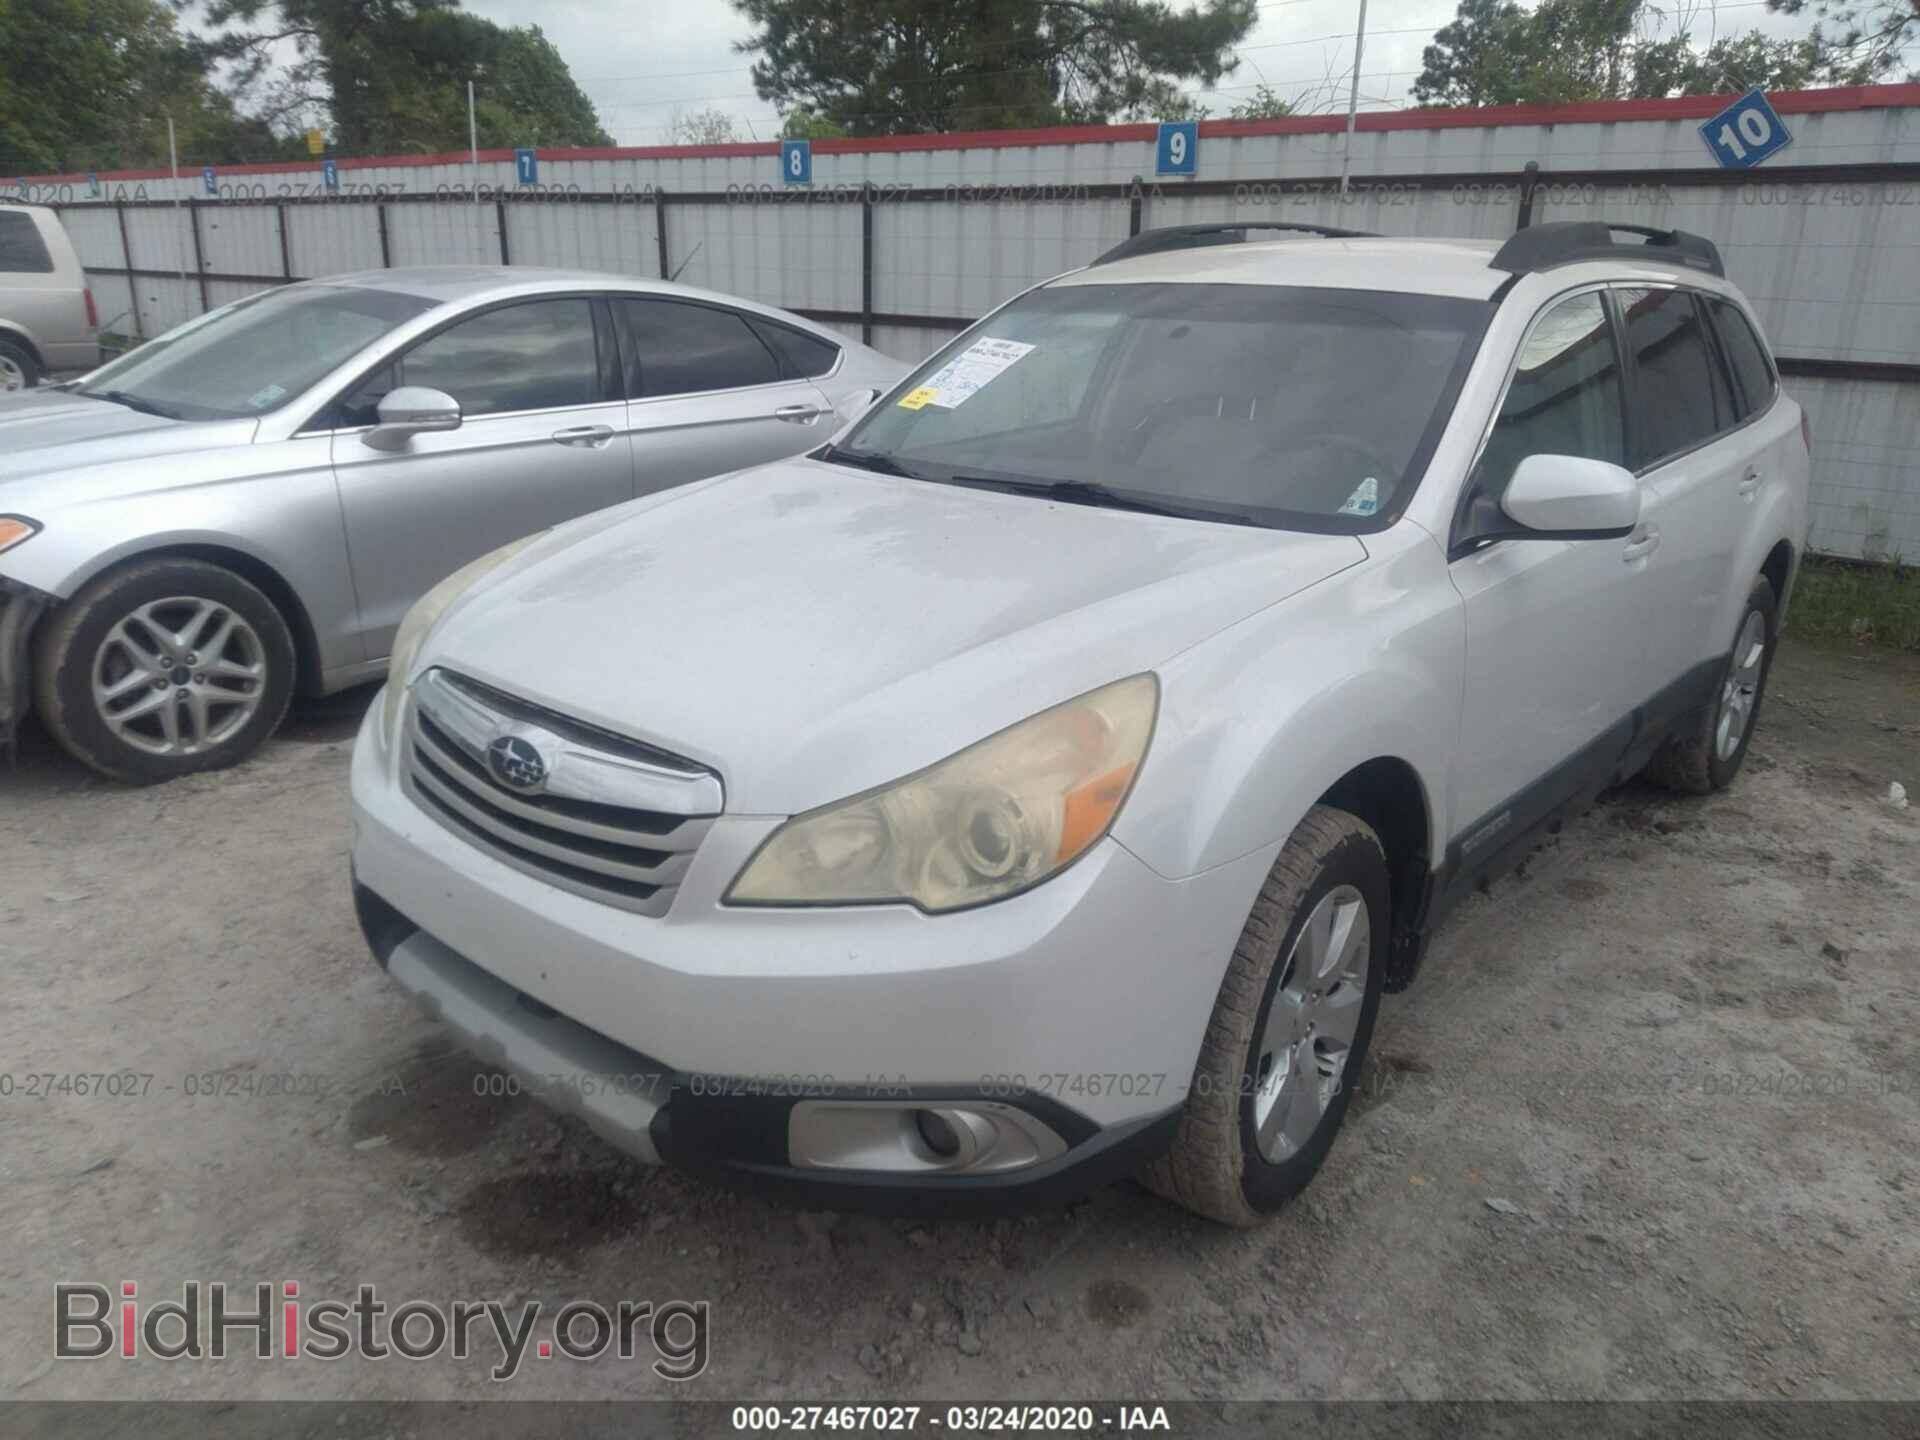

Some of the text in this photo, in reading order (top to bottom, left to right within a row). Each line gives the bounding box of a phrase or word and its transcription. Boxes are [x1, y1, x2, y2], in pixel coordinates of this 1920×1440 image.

[1170, 131, 1187, 166] 9
[1717, 107, 1772, 160] 10
[521, 155, 531, 177] 7
[790, 149, 802, 176] 8
